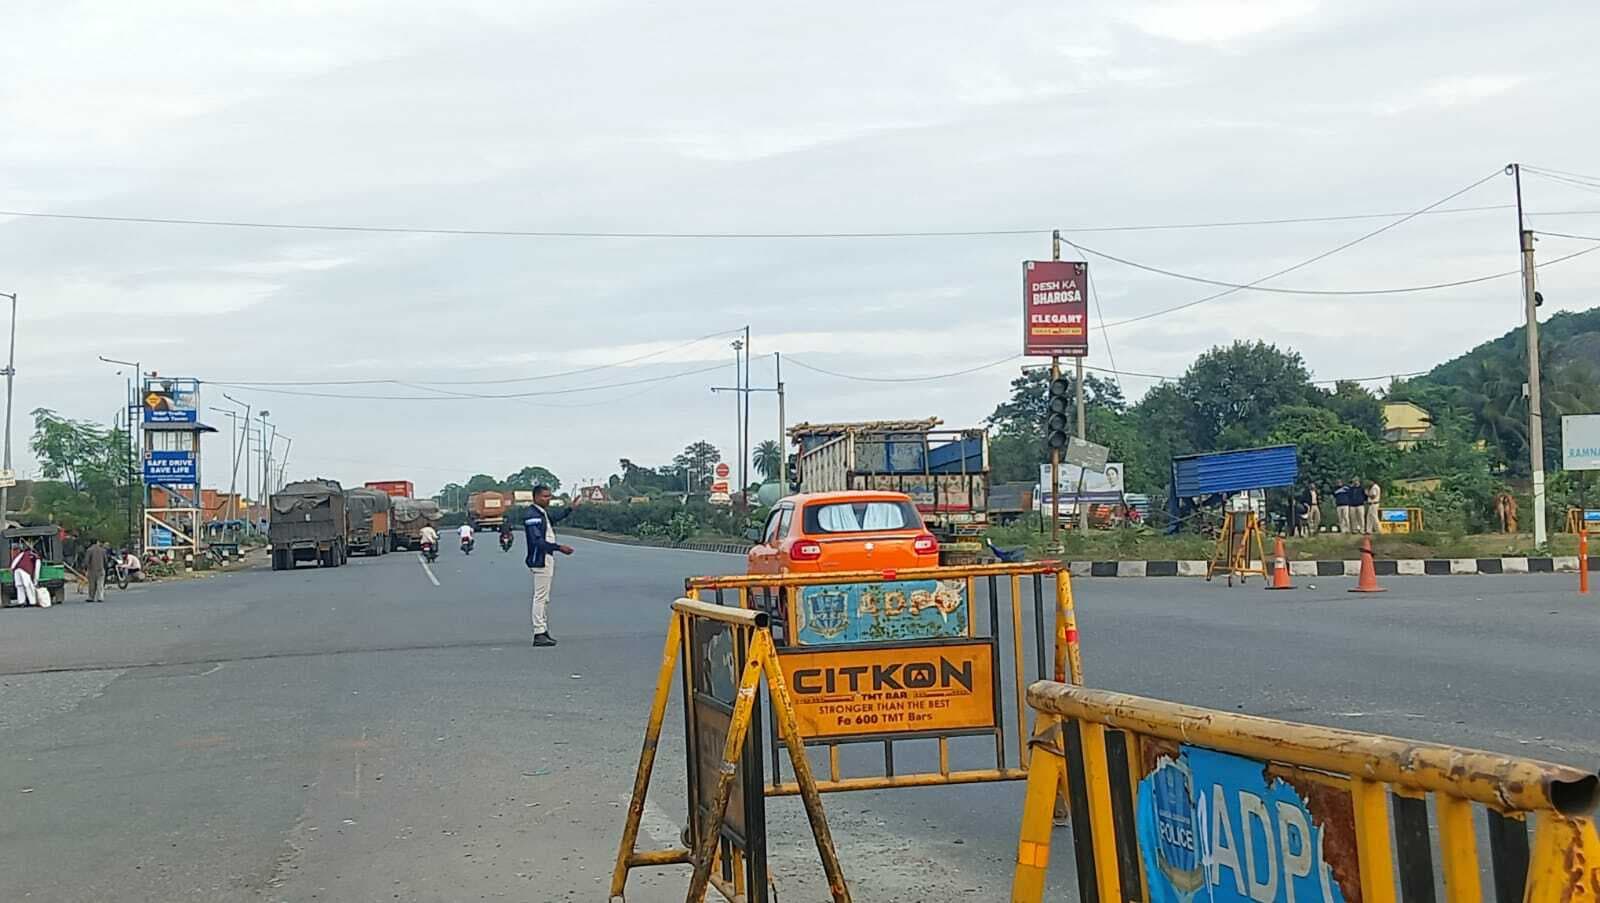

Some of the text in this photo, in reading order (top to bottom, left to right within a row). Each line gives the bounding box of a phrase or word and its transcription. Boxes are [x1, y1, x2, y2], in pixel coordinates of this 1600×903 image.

[1032, 279, 1076, 291] DESH KA
[1033, 290, 1081, 305] BHAROSA
[1031, 314, 1082, 323] ELEGANT
[792, 656, 973, 695] CITKON
[861, 691, 908, 701] TMT BAR
[818, 699, 950, 715] STRONGER THAN THE BEST
[854, 714, 878, 725] 600
[882, 713, 904, 723] TMT
[907, 712, 933, 722] Bars
[1160, 821, 1194, 850] POLICE
